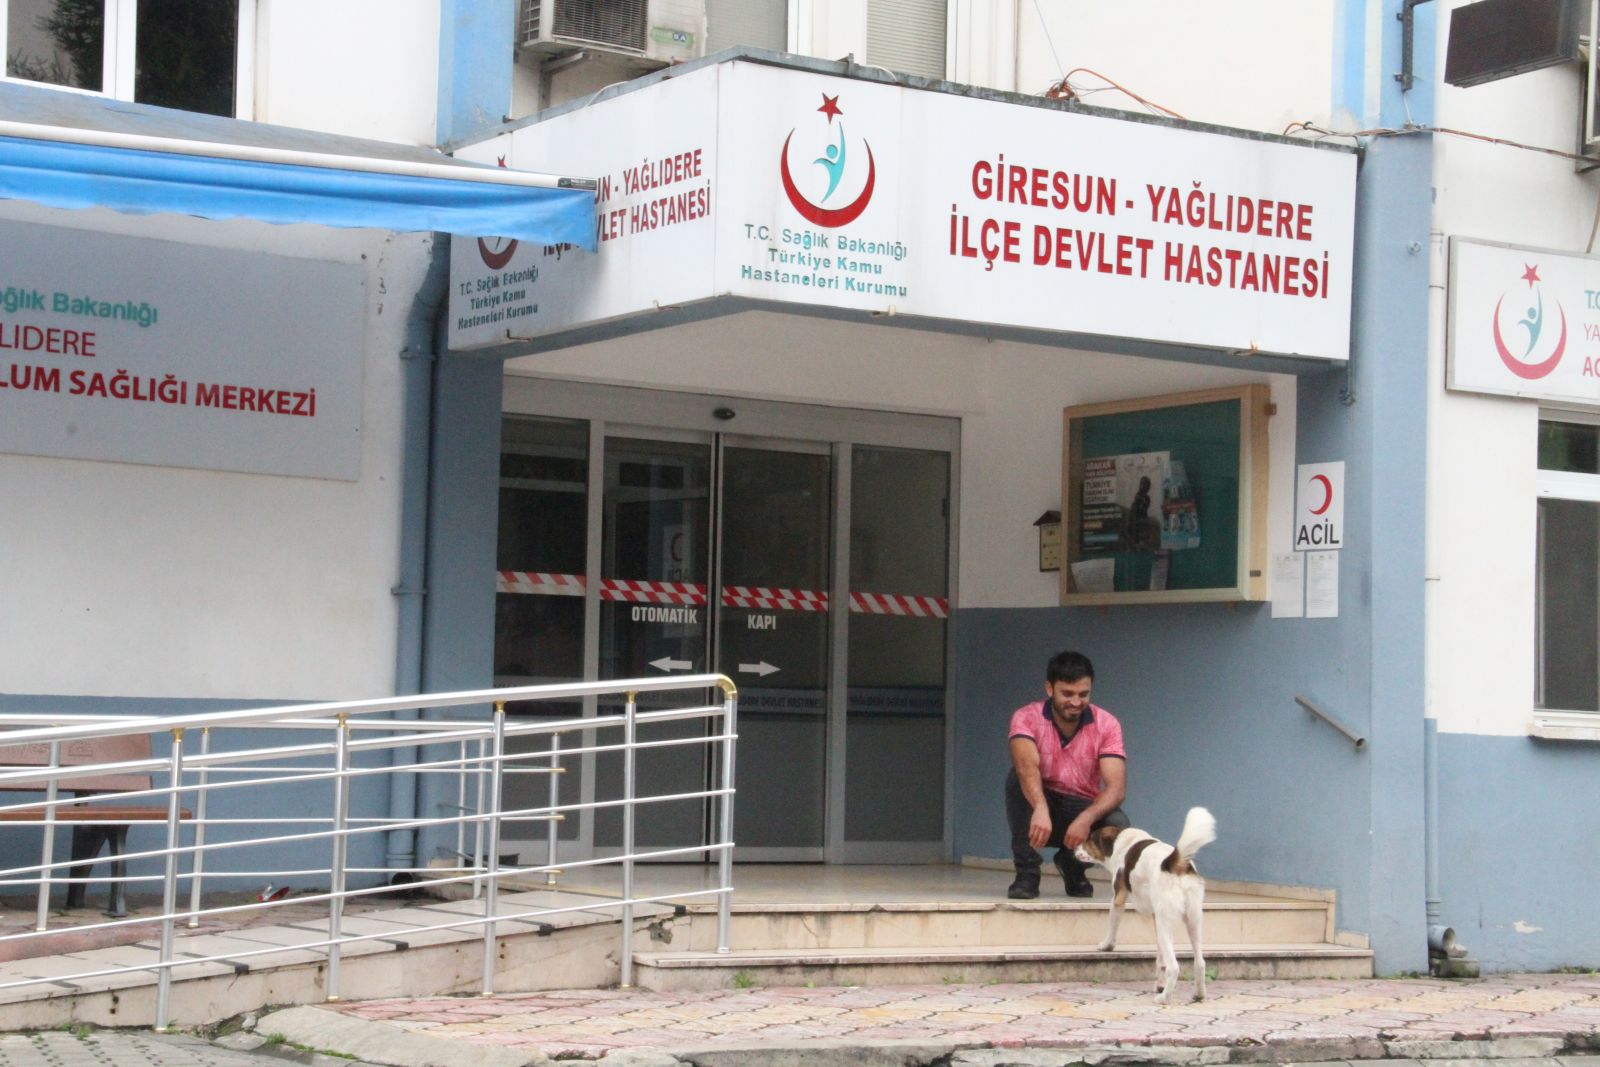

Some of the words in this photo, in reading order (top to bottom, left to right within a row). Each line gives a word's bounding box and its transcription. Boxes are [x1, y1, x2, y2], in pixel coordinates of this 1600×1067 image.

[623, 149, 702, 196] YAĞLIDERE
[631, 178, 710, 234] HASTANESİ
[972, 153, 1117, 216] GİRESUN
[1126, 199, 1134, 209] -
[1146, 180, 1313, 242] YAĞLIDERE
[744, 223, 773, 241] T.C.
[782, 228, 829, 250] Sağlık
[837, 235, 907, 261] Bakanlığı
[950, 203, 1021, 271] İLÇE
[1033, 224, 1154, 279] DEVLET
[1165, 250, 1328, 299] HASTANESİ
[768, 247, 832, 271] Türkiye
[837, 256, 883, 275] Kamu
[741, 265, 839, 290] Hastaneleri
[845, 276, 908, 297] Kurumu
[52, 292, 158, 328] Bakanlığı
[470, 294, 500, 310] Türkiye
[503, 289, 526, 303] Kamu
[458, 308, 504, 330] Hastaneleri
[506, 304, 538, 319] Kurumu
[69, 368, 187, 405] SAĞLIĞI
[195, 382, 316, 417] MERKEZİ
[1297, 517, 1340, 546] ACİL
[631, 604, 698, 624] OTOMATİK
[747, 614, 777, 630] KAPI
